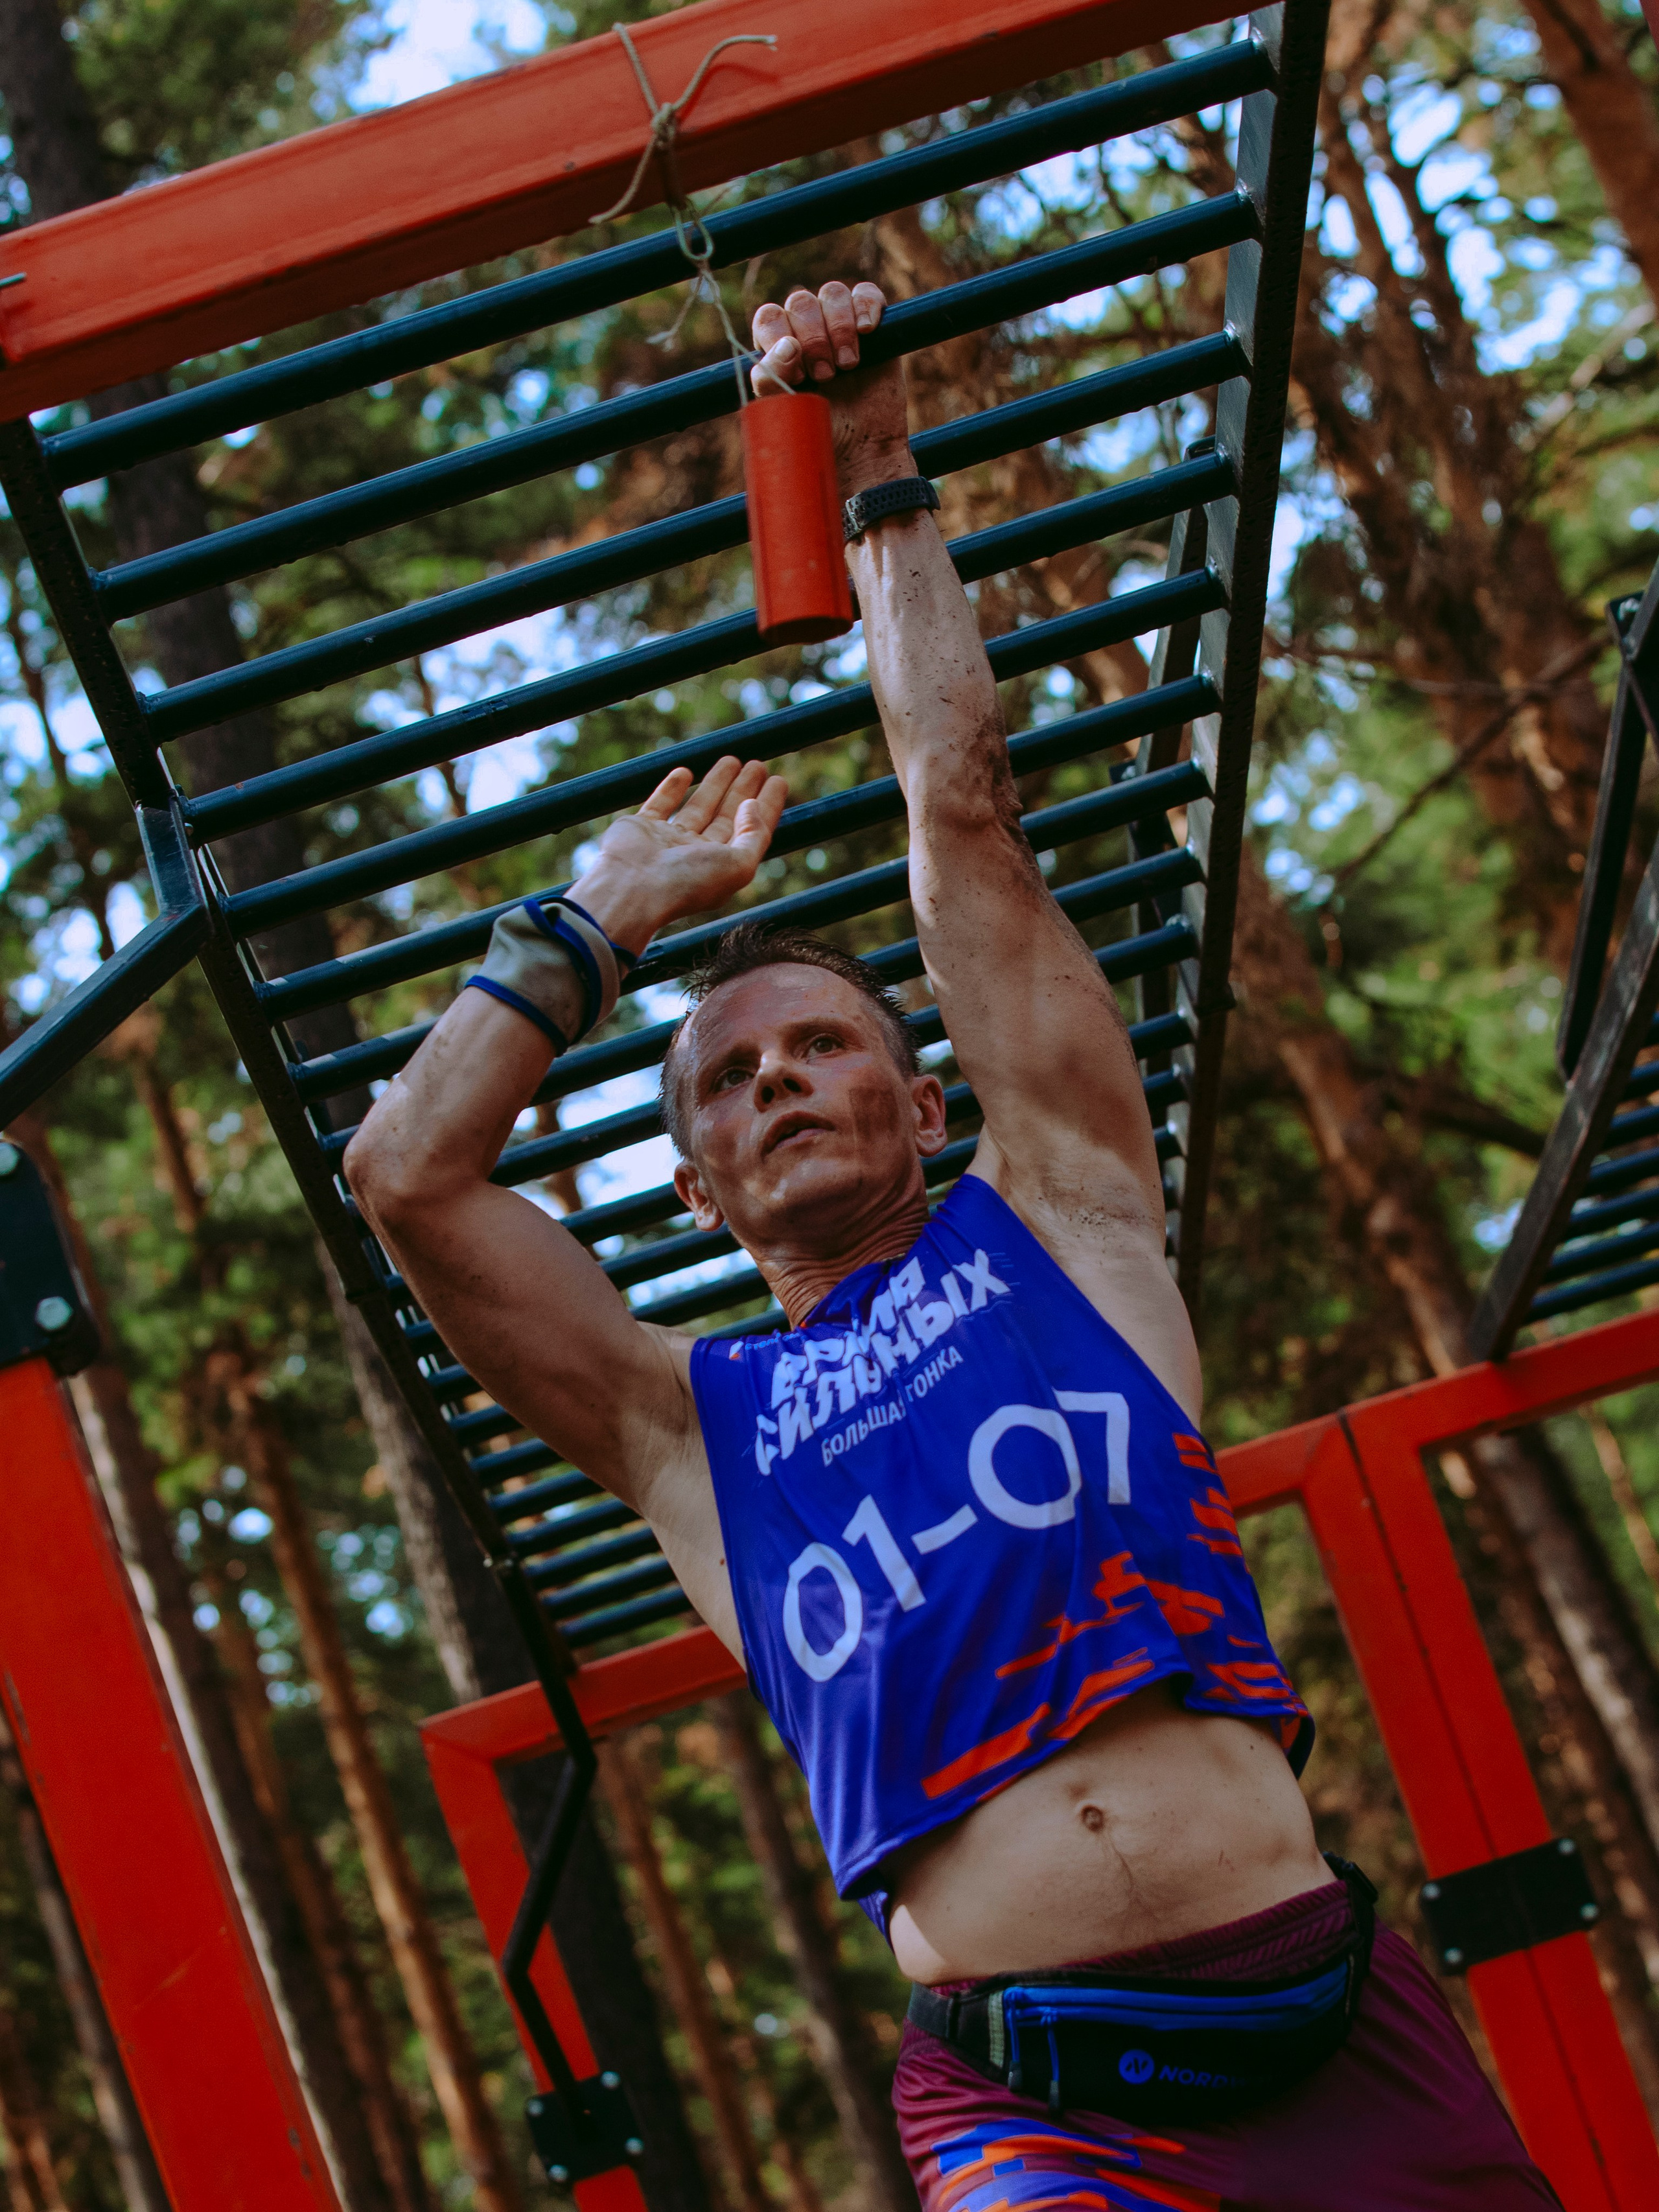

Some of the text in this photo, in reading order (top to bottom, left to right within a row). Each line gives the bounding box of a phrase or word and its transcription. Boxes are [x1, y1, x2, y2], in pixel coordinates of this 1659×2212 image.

[755, 1248, 1011, 1476] СИЛЬНЫХ
[771, 1256, 925, 1411] ВРМЯ
[905, 1345, 964, 1402] ГОНКА
[1158, 2064, 1251, 2088] NORD
